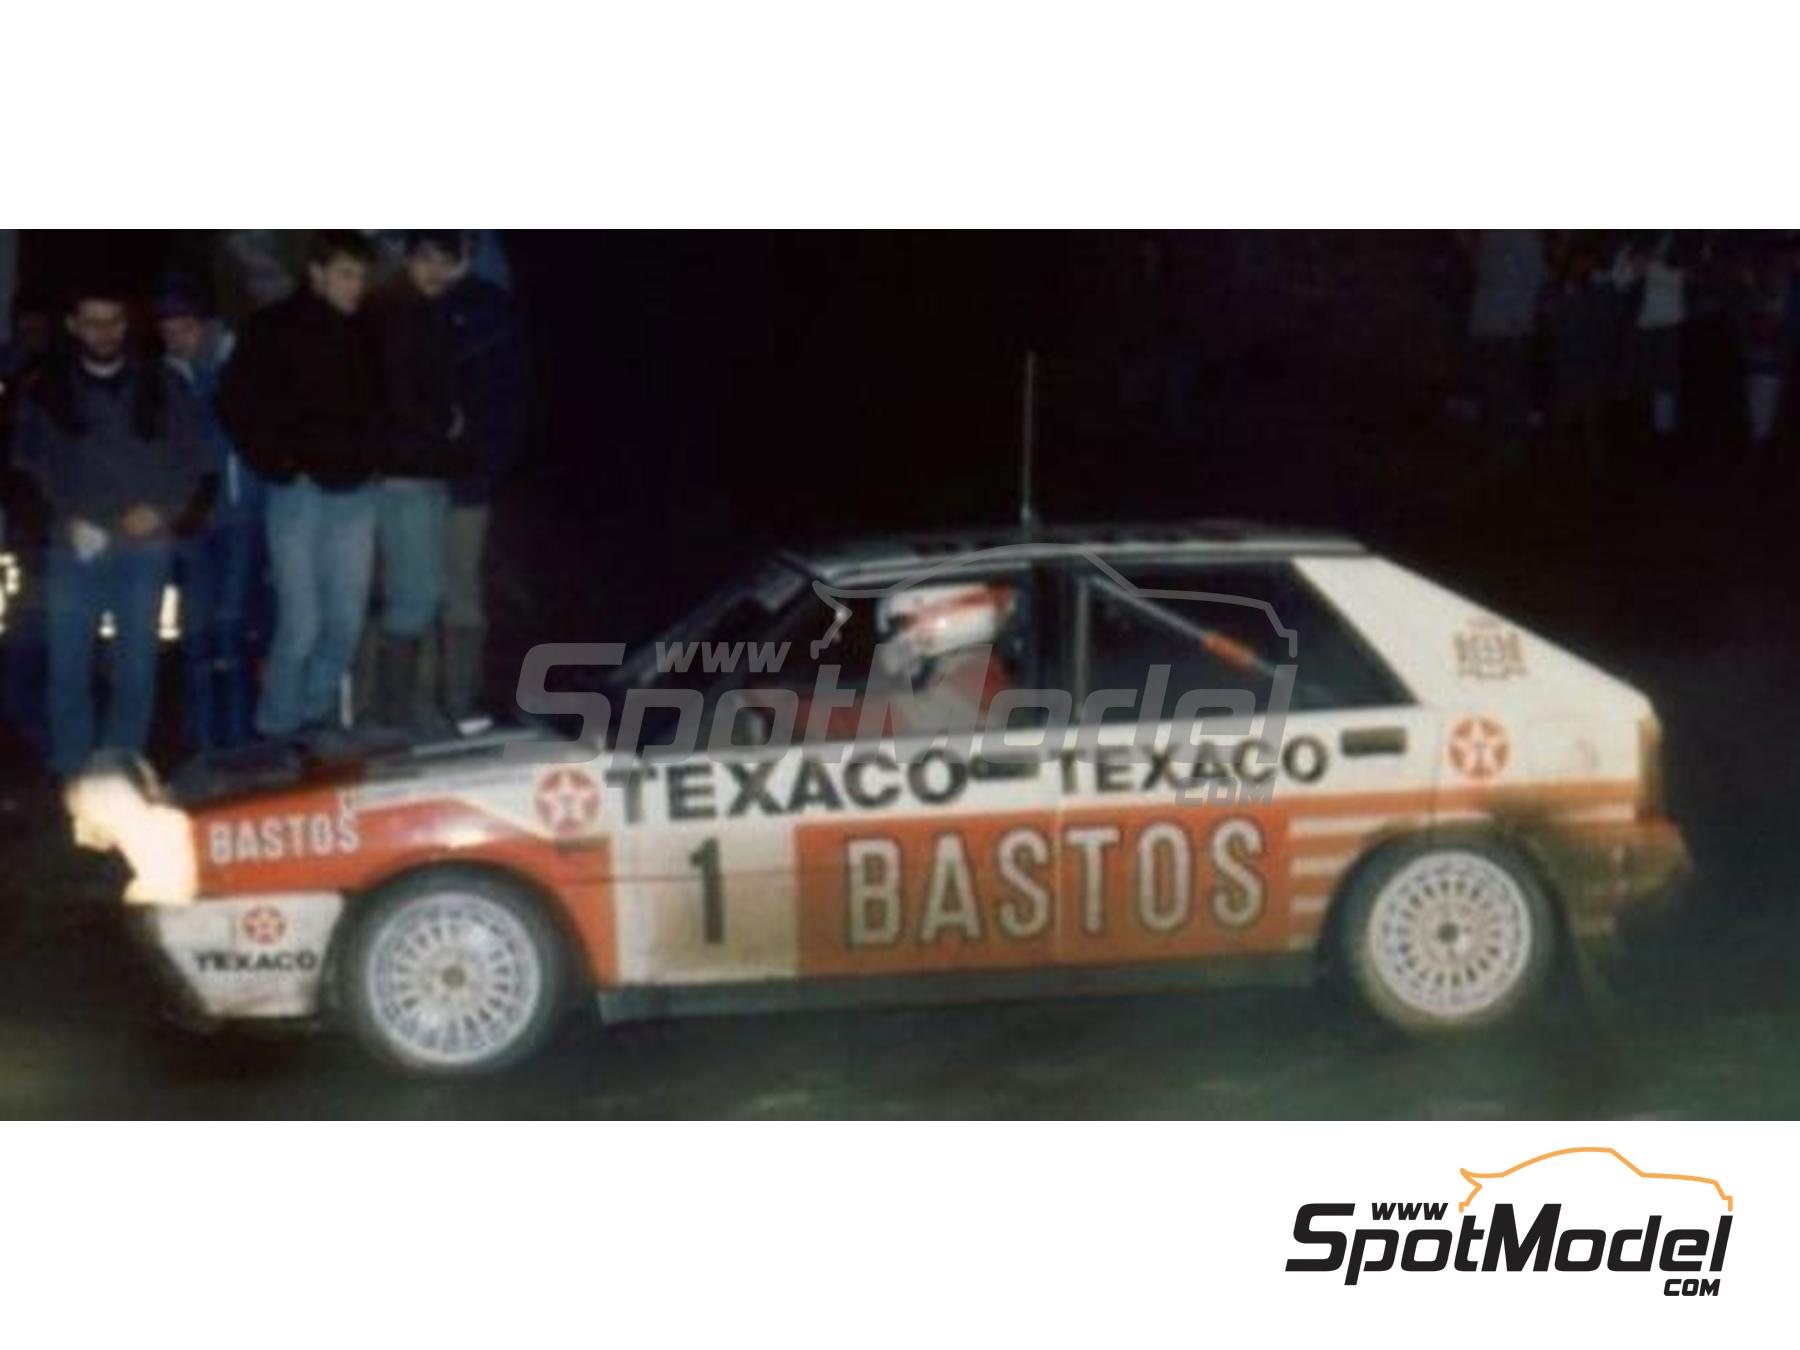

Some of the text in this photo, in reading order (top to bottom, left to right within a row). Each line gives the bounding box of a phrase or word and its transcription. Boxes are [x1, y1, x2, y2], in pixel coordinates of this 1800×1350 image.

[604, 748, 969, 826] TEXACO
[1055, 735, 1330, 793] TEXACO
[209, 811, 361, 865] BASTOS
[689, 836, 727, 946] 1
[845, 817, 1268, 947] BASTOS
[195, 950, 318, 972] TEXACO
